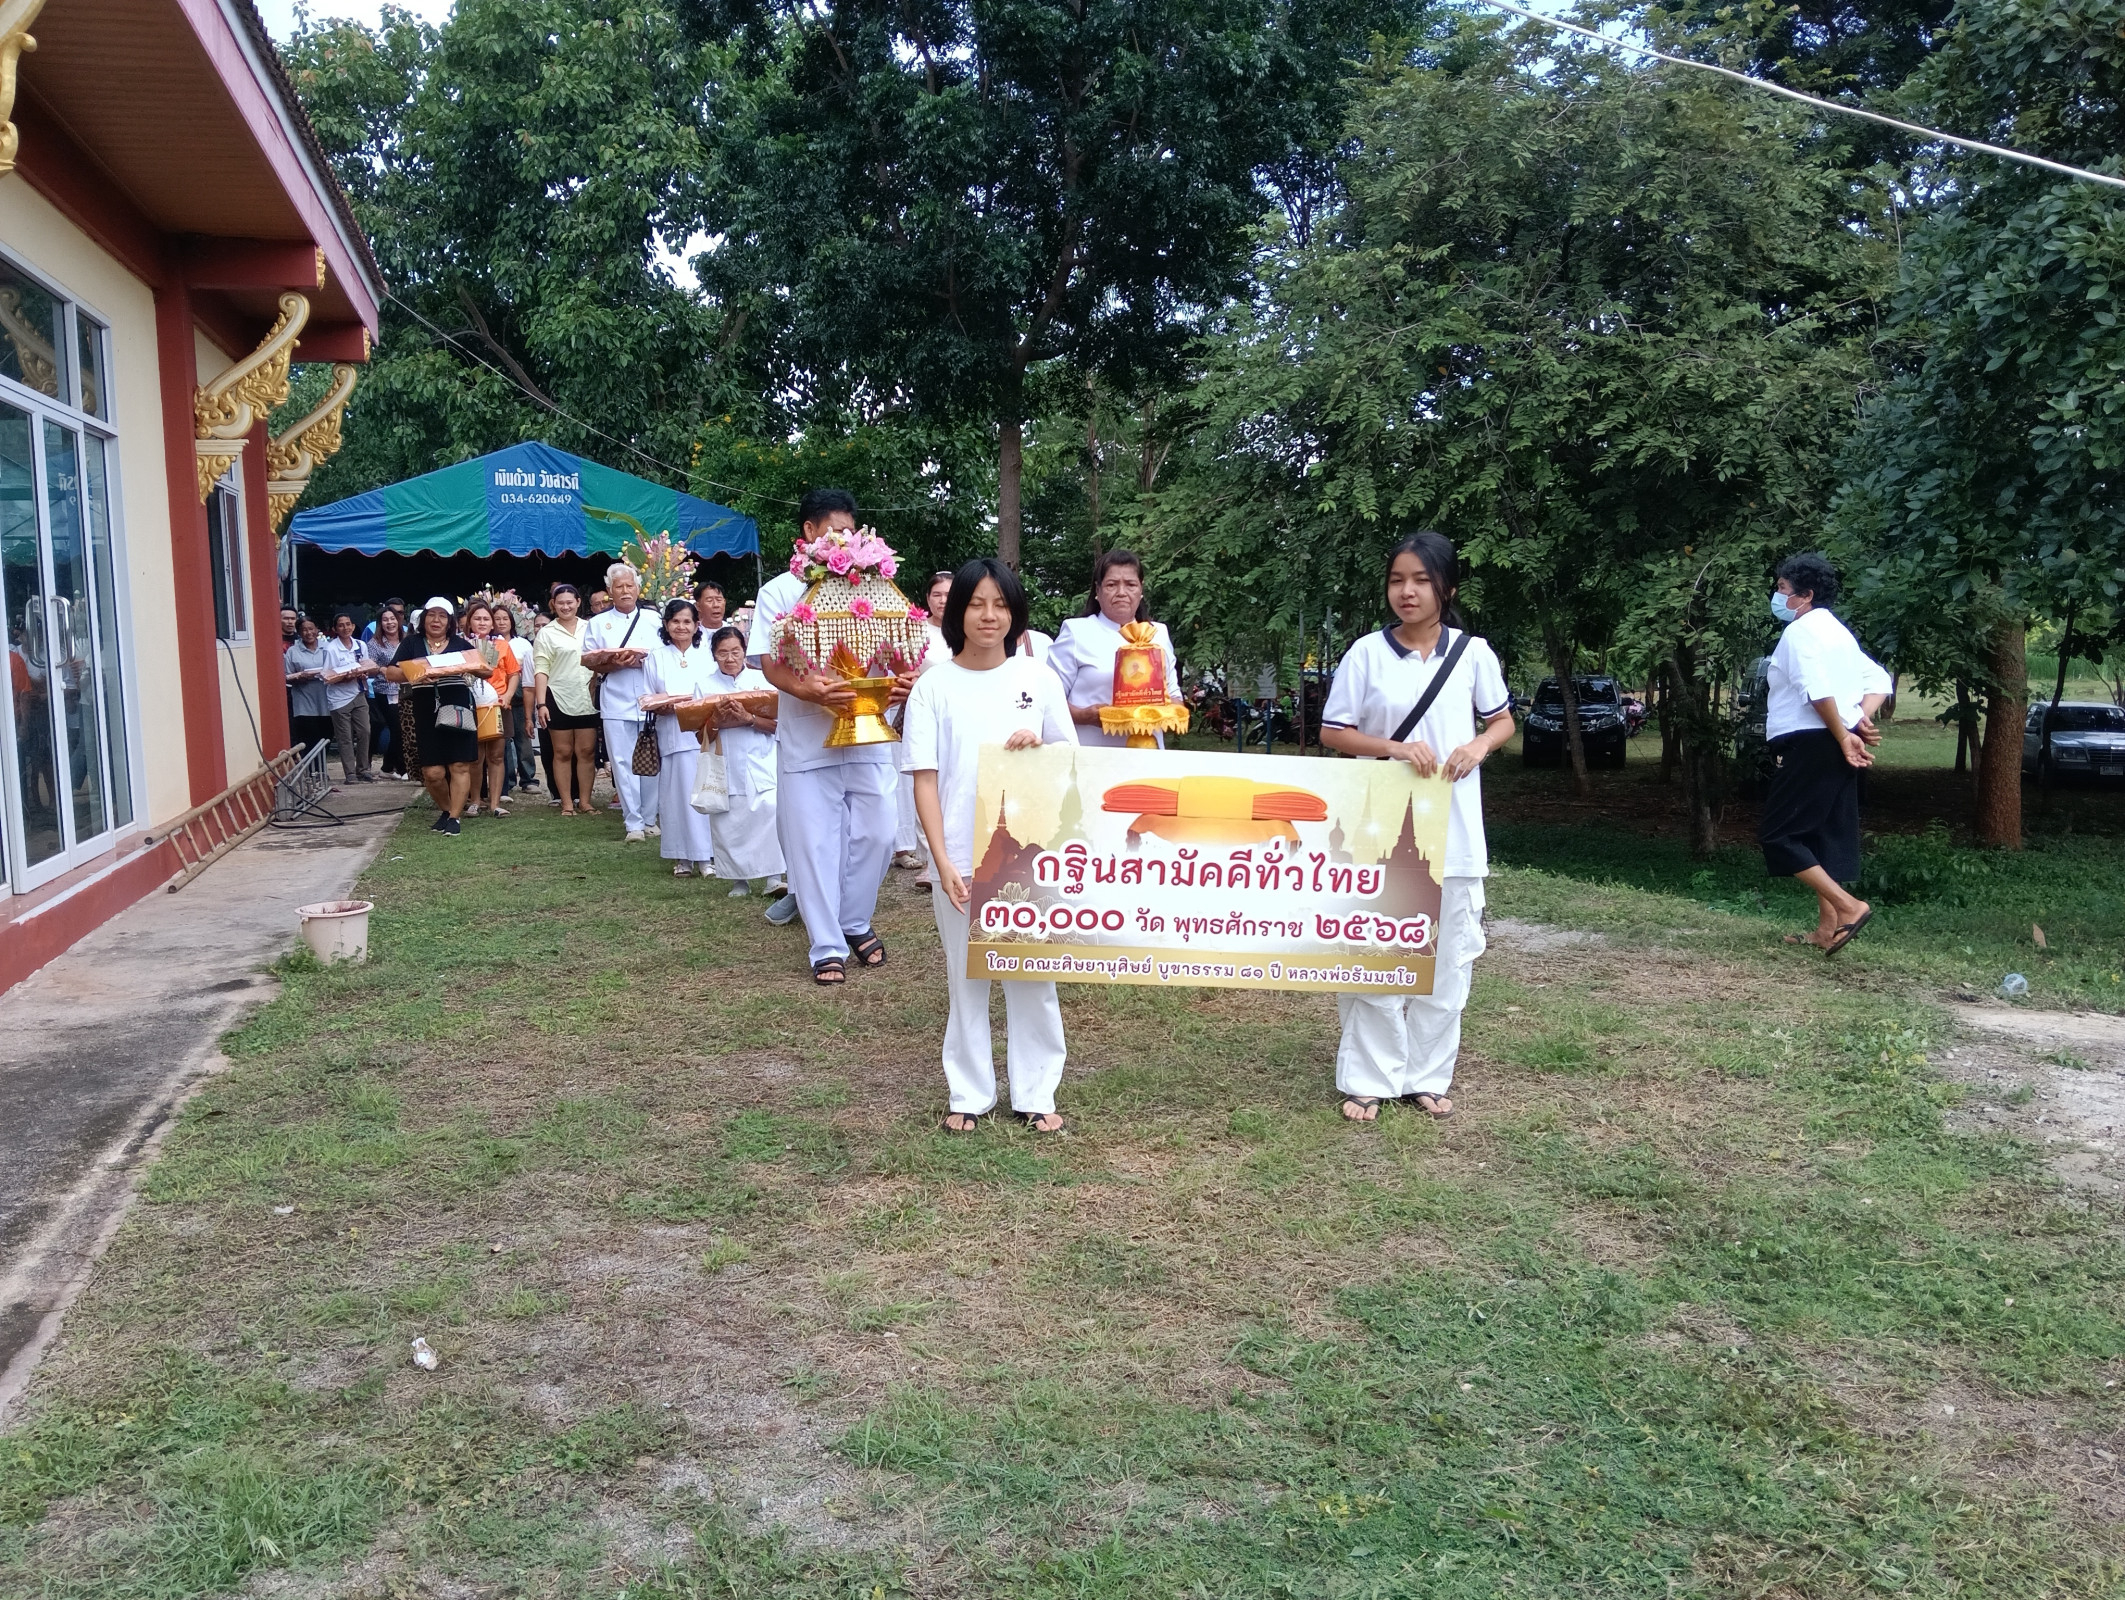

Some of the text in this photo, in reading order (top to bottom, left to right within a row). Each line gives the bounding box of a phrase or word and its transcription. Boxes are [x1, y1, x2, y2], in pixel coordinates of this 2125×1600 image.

[501, 493, 572, 504] 034-620649
[1037, 840, 1380, 895] กฐินสามัคคีทั่วไทย
[1136, 907, 1165, 933] วัด
[1174, 911, 1303, 943] พุทธศักราช
[1315, 914, 1427, 943] ๒๕๖๘
[987, 953, 1018, 970] โดย
[1025, 957, 1152, 978] คณะศิษยานุศิษย์
[1159, 963, 1234, 980] บูชาธรรม
[1271, 963, 1282, 979] ปี
[1288, 967, 1416, 985] หลวงพ่อธัมมชโย
